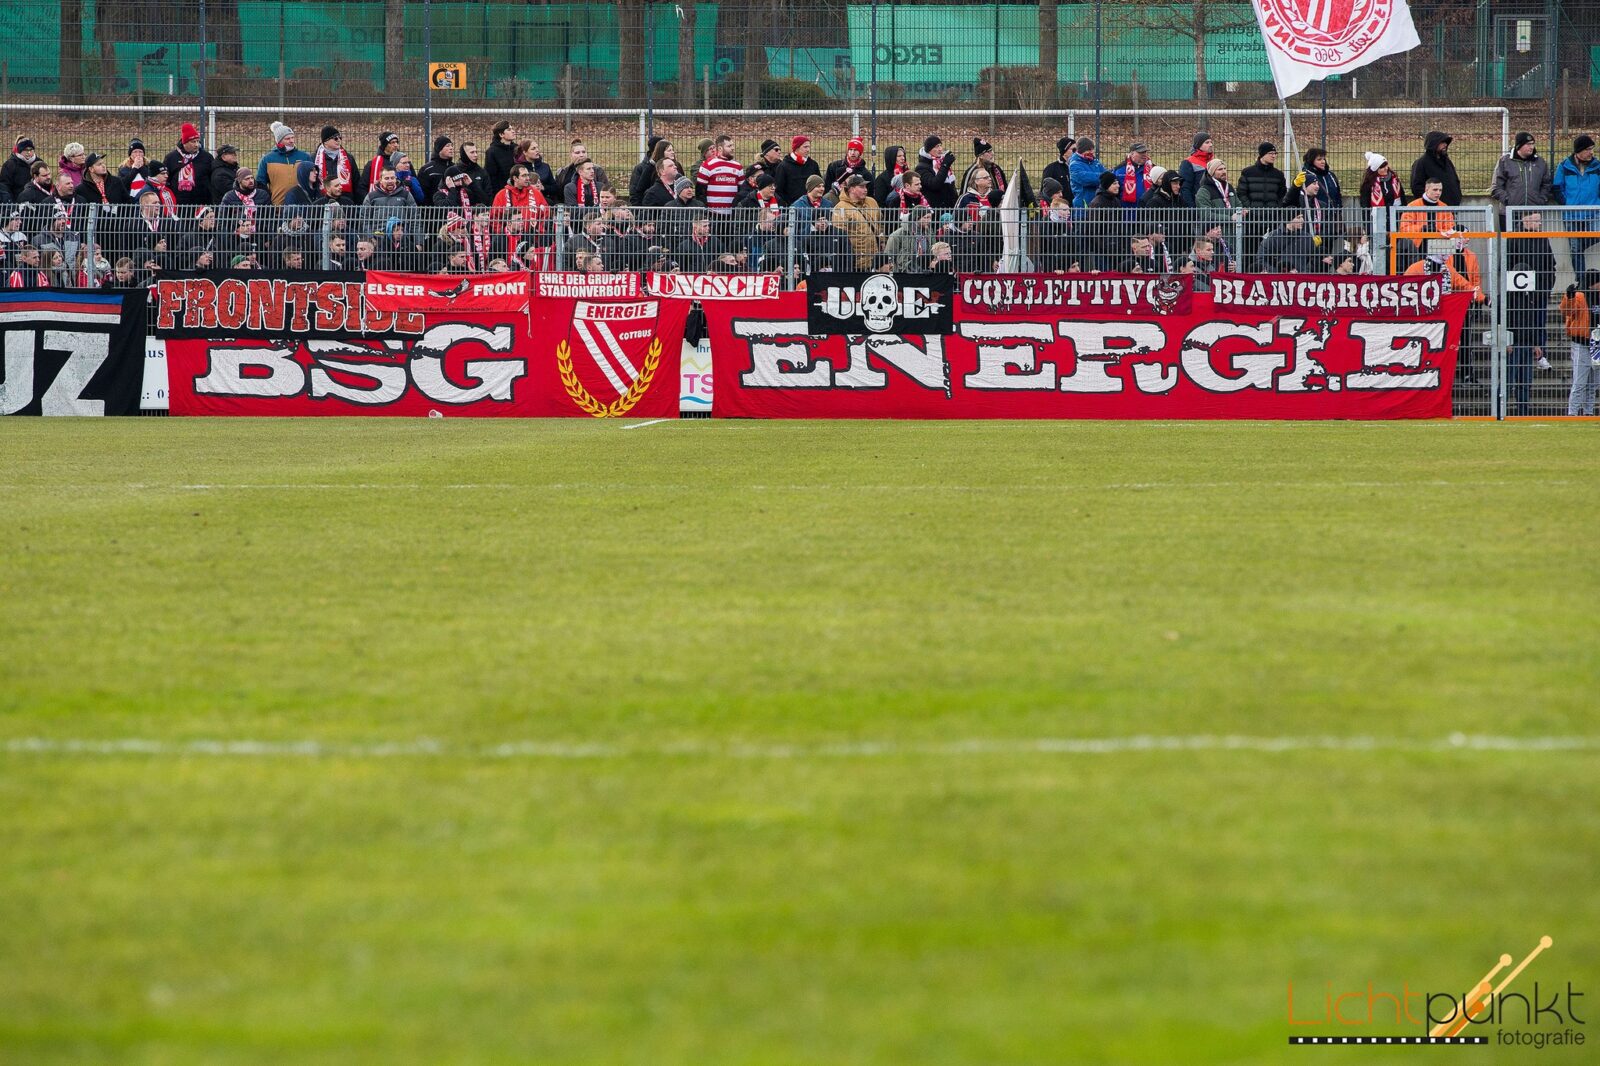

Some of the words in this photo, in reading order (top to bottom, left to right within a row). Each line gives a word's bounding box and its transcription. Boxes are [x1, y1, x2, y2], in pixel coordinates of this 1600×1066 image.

[539, 273, 564, 285] EHRE
[565, 273, 586, 285] DER
[587, 273, 627, 285] GRUPPE
[1513, 273, 1529, 289] C
[367, 283, 425, 297] ELSTER
[473, 281, 527, 297] FRONT
[539, 285, 628, 298] STADIONVERBOT
[1211, 278, 1440, 311] BIANCOROSSO
[586, 303, 648, 318] ENERGIE
[618, 329, 652, 341] COTTBUS
[193, 320, 528, 406] BSG
[731, 316, 1447, 396] ENERGIE
